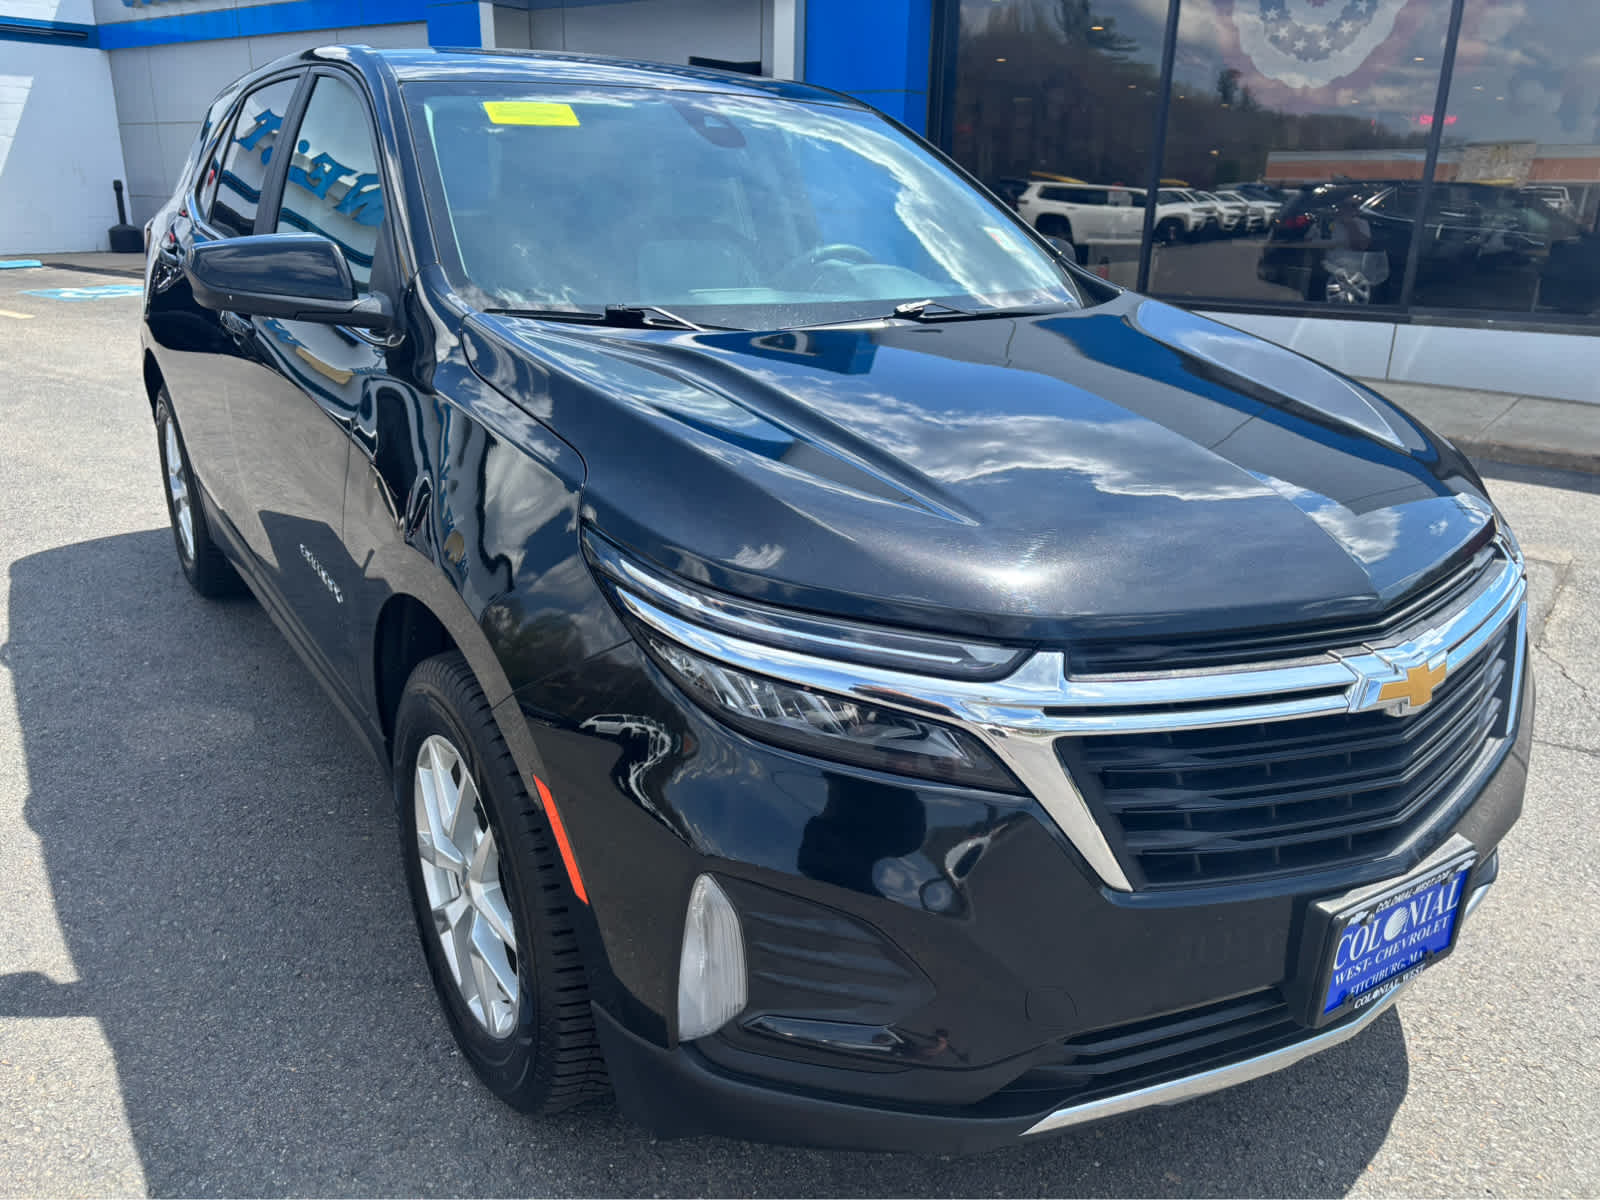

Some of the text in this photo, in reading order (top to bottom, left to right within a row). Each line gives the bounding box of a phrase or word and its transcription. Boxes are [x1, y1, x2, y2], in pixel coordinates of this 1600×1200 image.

[1333, 878, 1459, 971] COLONIAL
[1375, 914, 1451, 964] CHEVROLET
[1354, 963, 1426, 1009] COLONIAL WEST
